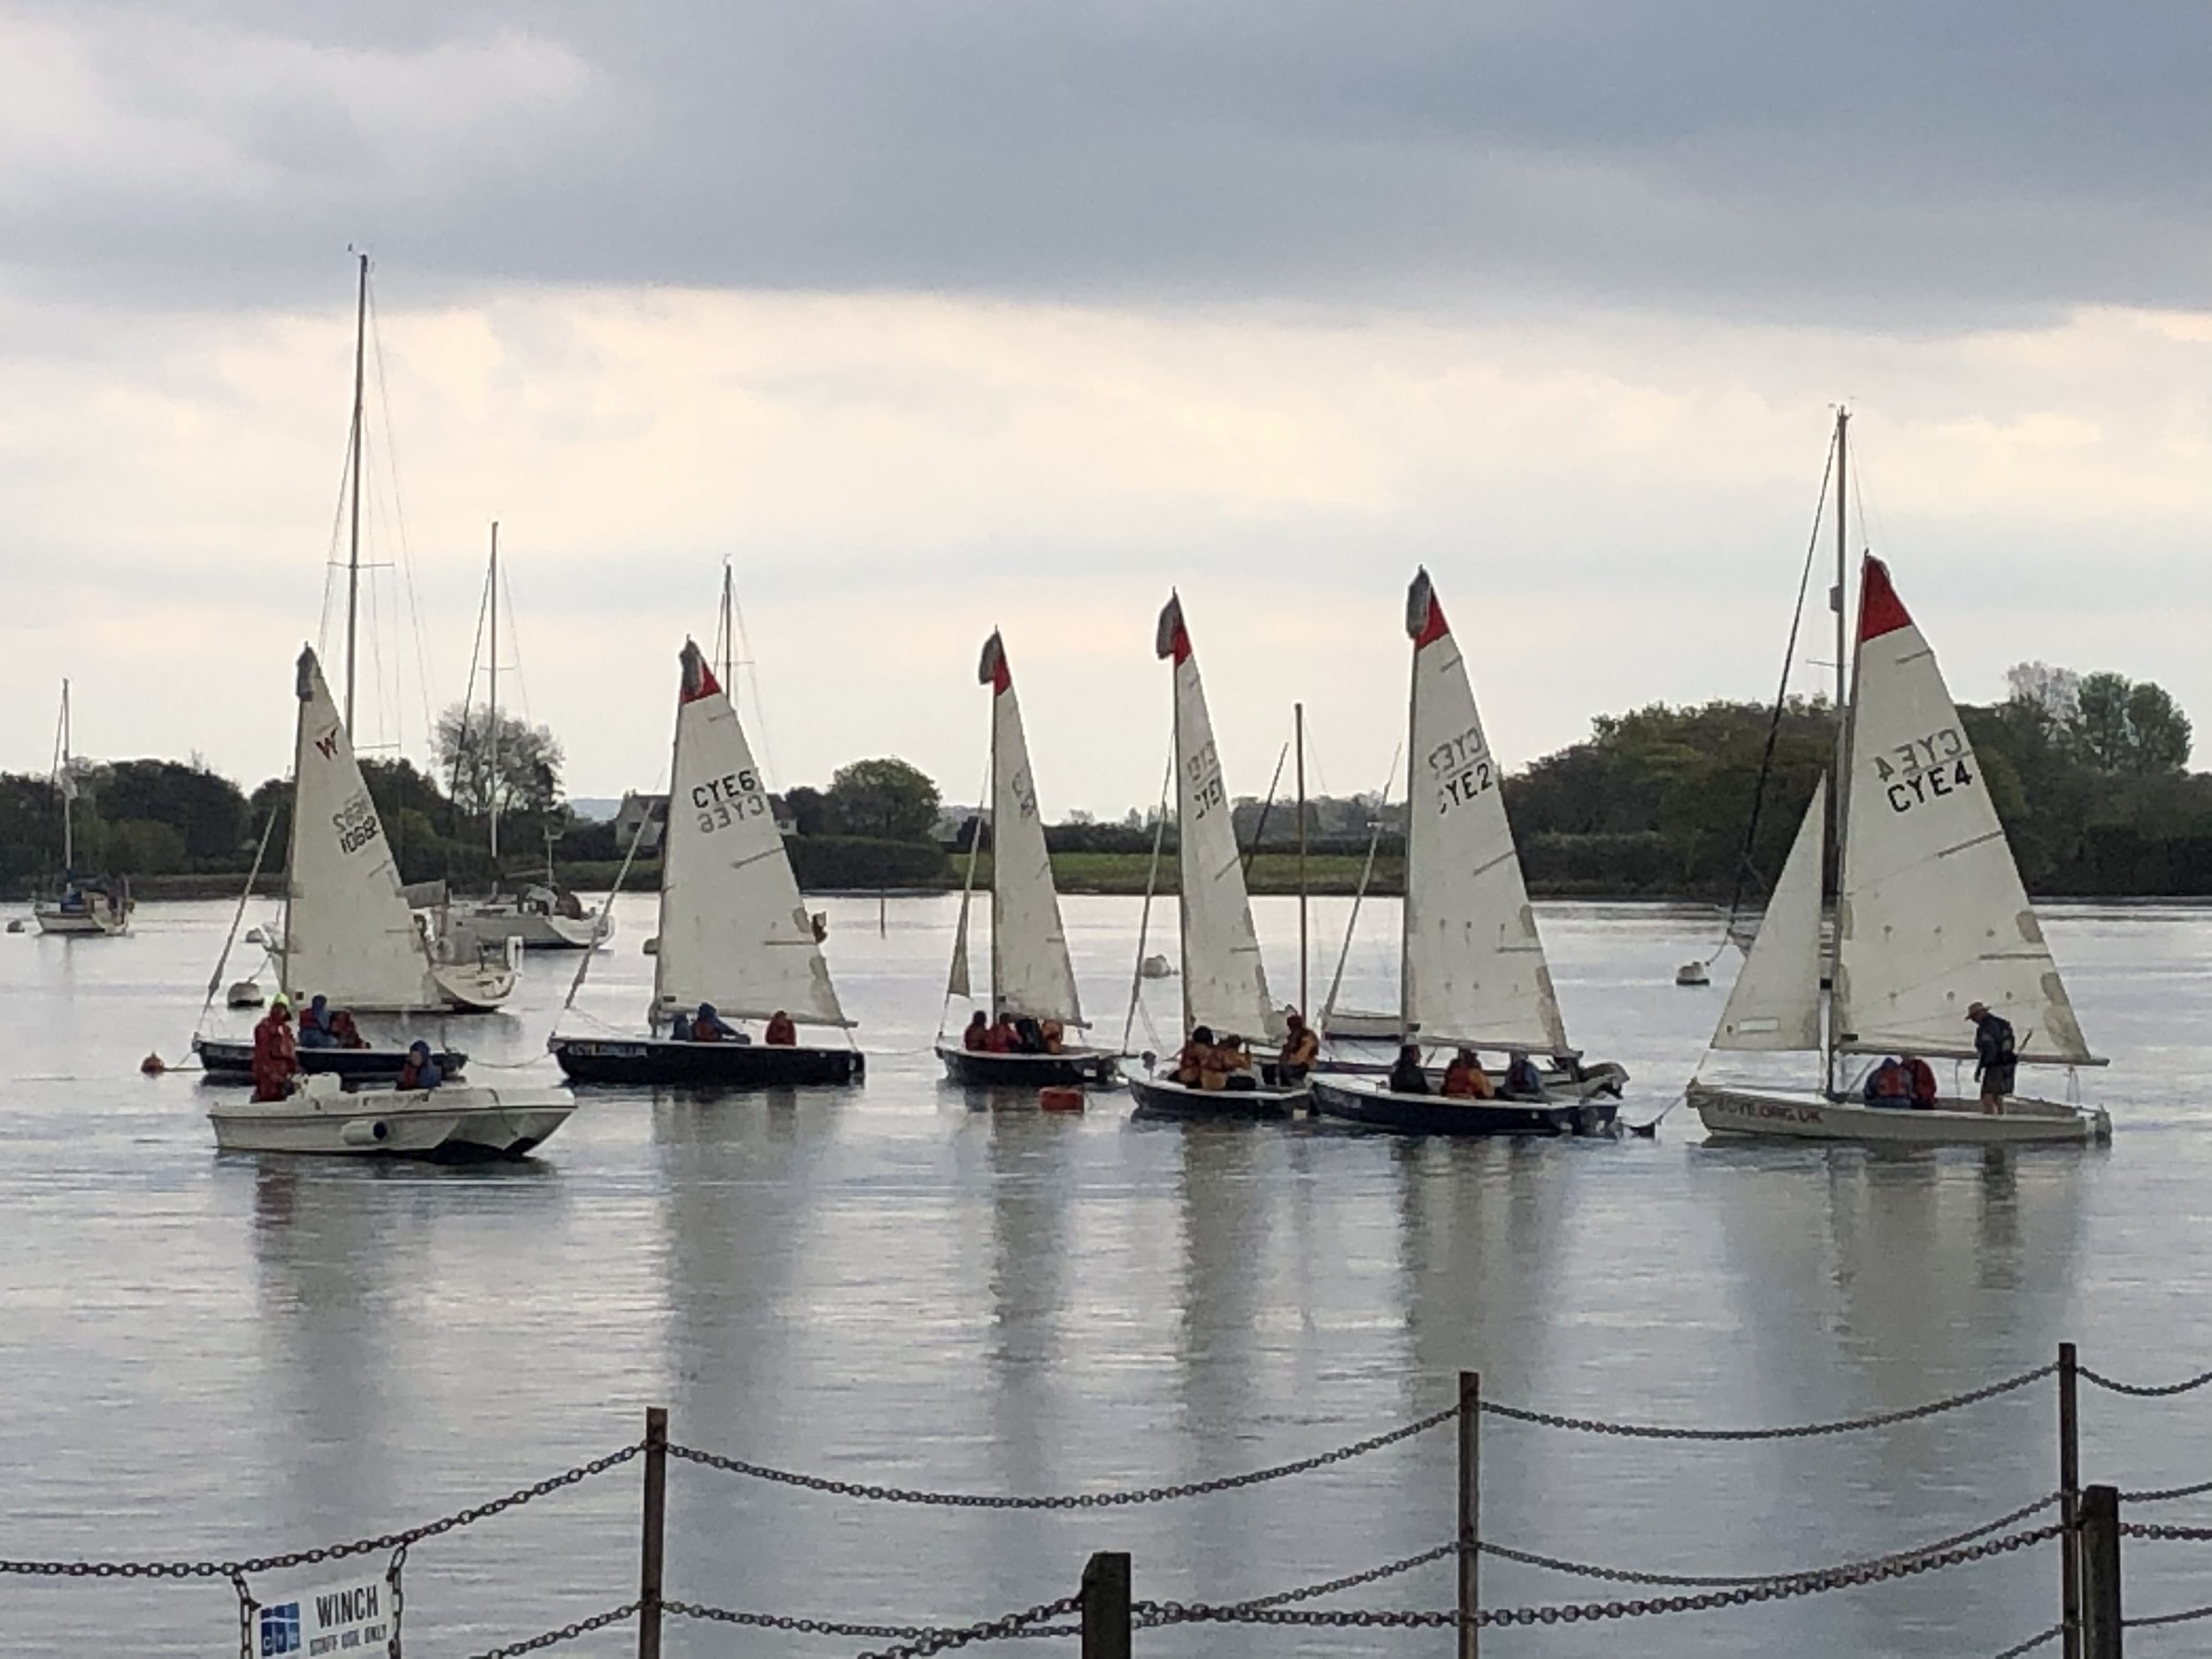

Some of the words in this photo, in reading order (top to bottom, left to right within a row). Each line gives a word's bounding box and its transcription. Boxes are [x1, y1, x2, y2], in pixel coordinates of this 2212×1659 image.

[691, 769, 757, 809] CYE6
[1886, 758, 1973, 813] CYE4
[315, 1583, 379, 1630] WINCH
[364, 1623, 388, 1645] ONLY
